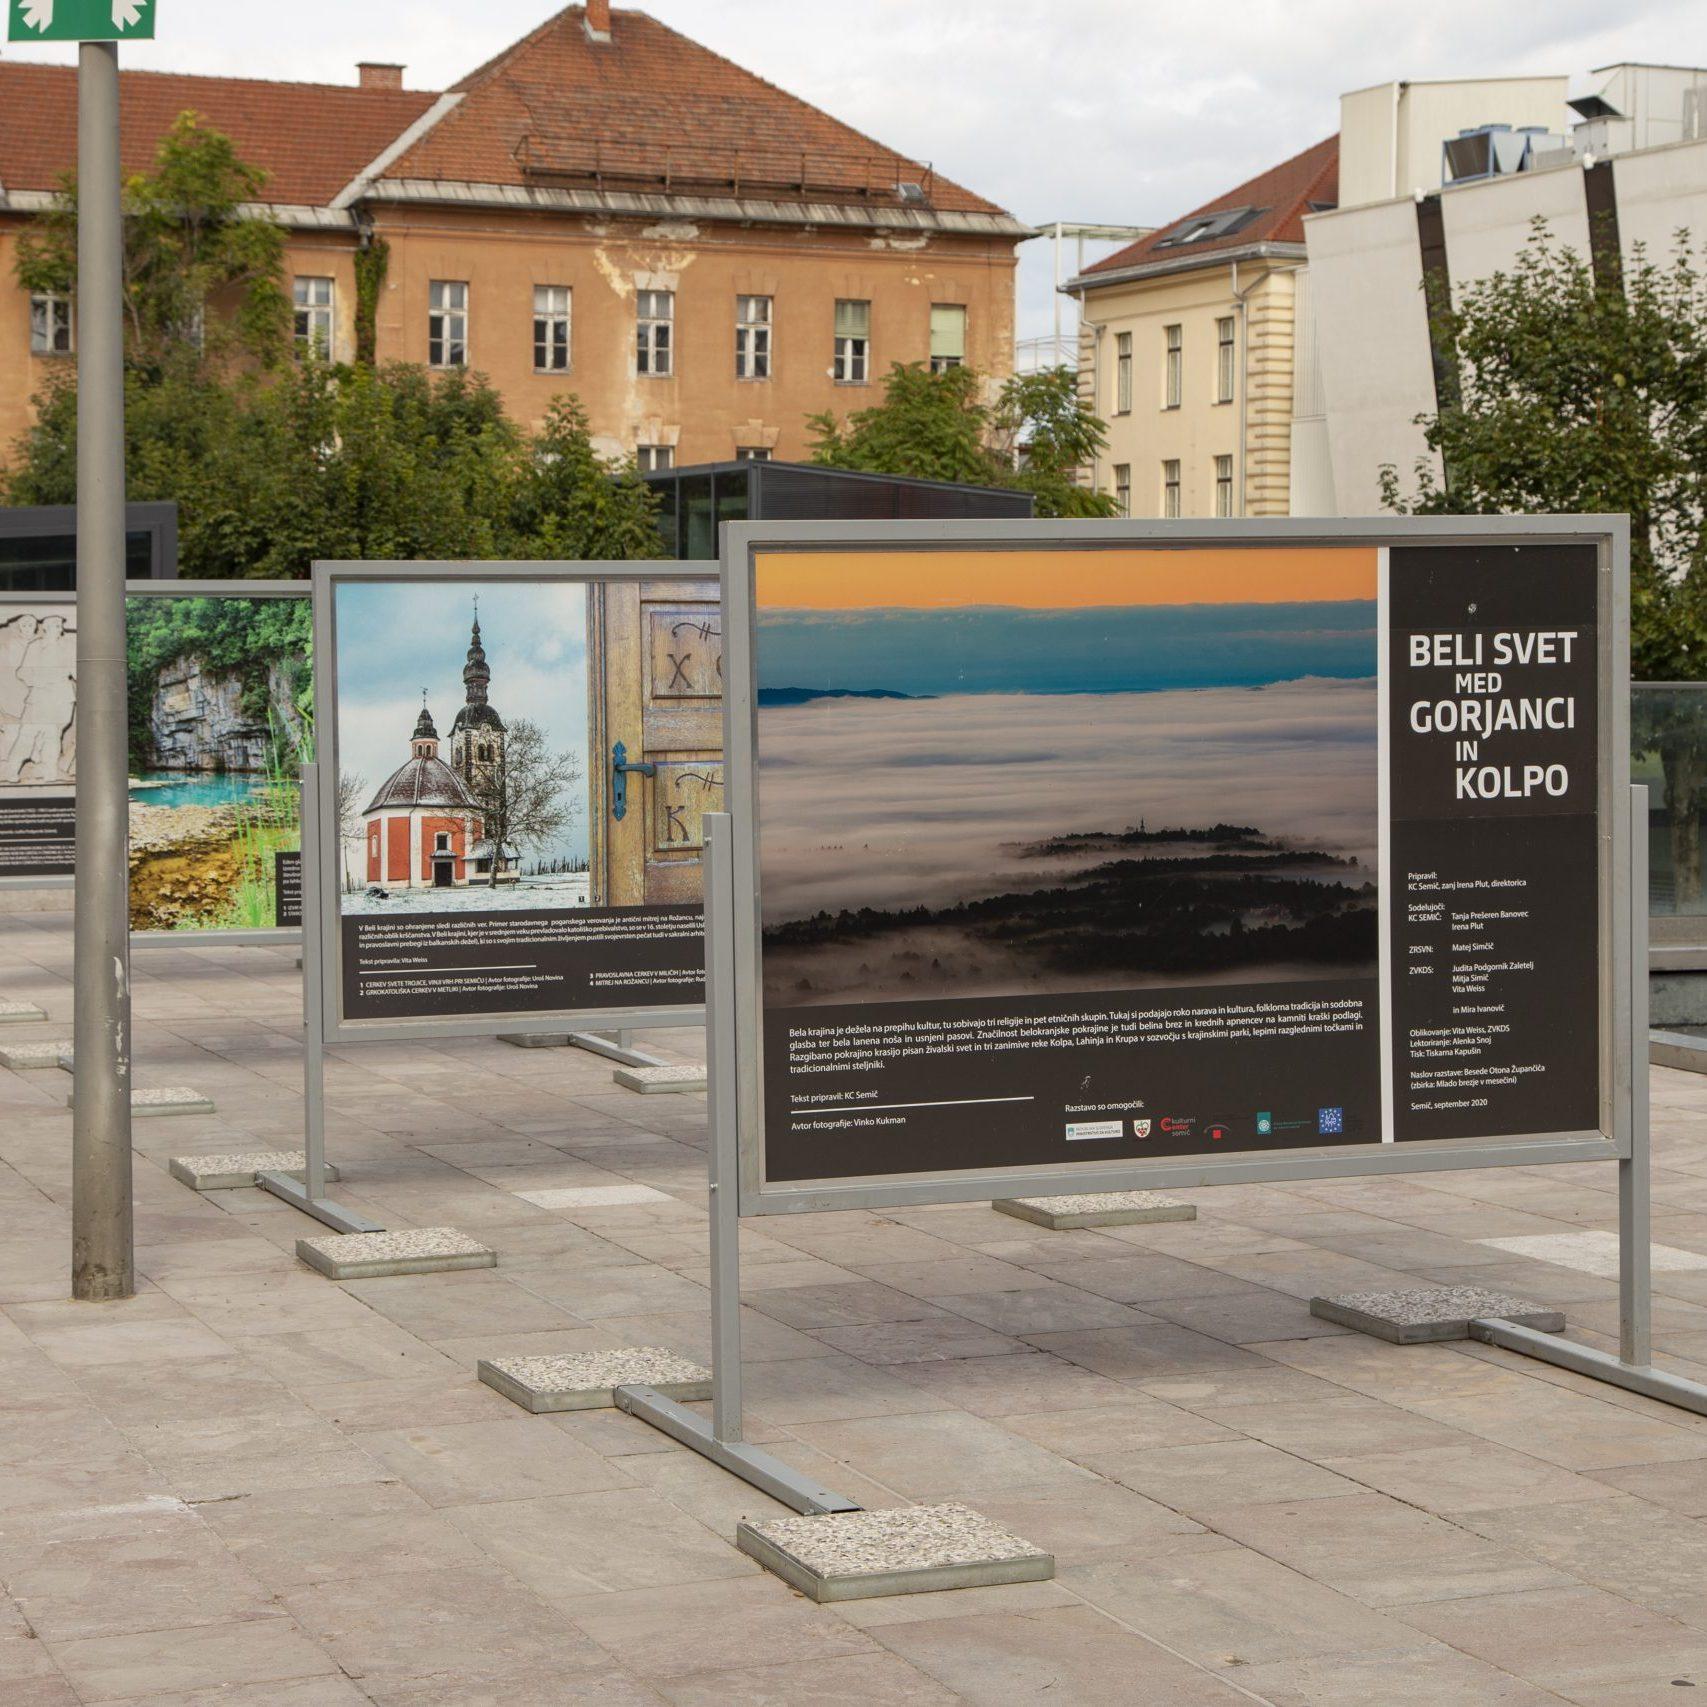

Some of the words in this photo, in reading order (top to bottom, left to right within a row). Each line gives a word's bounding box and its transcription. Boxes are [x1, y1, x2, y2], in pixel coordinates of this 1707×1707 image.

[1410, 634, 1482, 666] BELI
[1493, 632, 1578, 665] SVET
[1456, 672, 1502, 694] MED
[1410, 697, 1574, 740] GORJANCI
[1456, 740, 1478, 762] IN
[1456, 764, 1568, 799] KOLPO
[665, 805, 690, 842] K
[1442, 882, 1456, 890] zanj
[1457, 881, 1474, 889] Irena
[1475, 881, 1490, 889] Plut,
[1491, 879, 1526, 887] direktorica
[1451, 912, 1469, 921] Tanja
[1470, 922, 1484, 930] Plut
[1452, 943, 1471, 952] Matej
[1452, 964, 1473, 972] Judita
[1509, 962, 1534, 971] Zaletelj
[1452, 975, 1470, 984] Mitja
[1452, 985, 1465, 993] Vita
[1466, 984, 1485, 992] Weiss
[790, 1028, 807, 1037] Bela
[808, 1026, 835, 1037] krajina
[836, 1026, 844, 1036] je
[845, 1024, 871, 1034] dežela
[884, 1022, 915, 1034] prepihu
[917, 1021, 942, 1030] kultur,
[943, 1021, 952, 1029] tu
[953, 1019, 986, 1029] sobivajo
[987, 1018, 996, 1026] tri
[997, 1017, 1023, 1028] religije
[1025, 1016, 1032, 1024] in
[1033, 1016, 1046, 1026] pet
[1048, 1014, 1080, 1023] etničnih
[1081, 1012, 1109, 1023] skupin.
[1110, 1011, 1130, 1022] Tukaj
[1138, 1009, 1172, 1021] podajajo
[1173, 1008, 1191, 1017] roko
[1192, 1008, 1217, 1016] narava
[1218, 1006, 1226, 1015] in
[1227, 1005, 1255, 1014] kultura,
[1291, 1001, 1320, 1012] tradicija
[1330, 1000, 1363, 1009] sodobna
[790, 1039, 816, 1051] glasba
[833, 1038, 850, 1046] bela
[853, 1037, 880, 1045] lanena
[883, 1035, 902, 1044] noša
[905, 1034, 912, 1043] in
[916, 1032, 944, 1044] usnjeni
[947, 1031, 974, 1043] pasovi.
[977, 1029, 1018, 1039] Značilnost
[1020, 1026, 1070, 1037] belokranjske
[1072, 1024, 1109, 1036] pokrajine
[1111, 1024, 1119, 1034] je
[1121, 1022, 1136, 1031] tudi
[1140, 1021, 1163, 1030] belina
[1166, 1021, 1182, 1029] brez
[1185, 1020, 1192, 1028] in
[1195, 1018, 1224, 1028] krednih
[1226, 1018, 1263, 1028] apnencev
[1278, 1014, 1306, 1023] kamniti
[1308, 1012, 1330, 1022] kraški
[1332, 1011, 1363, 1022] podlagi.
[790, 1051, 832, 1062] Razgibano
[834, 1049, 872, 1061] pokrajino
[875, 1047, 900, 1058] krasijo
[902, 1046, 924, 1057] pisan
[926, 1044, 954, 1054] živalski
[956, 1044, 972, 1052] svet
[974, 1043, 982, 1051] in
[984, 1042, 992, 1051] tri
[994, 1040, 1030, 1050] zanimive
[1032, 1039, 1048, 1048] reke
[1050, 1038, 1074, 1048] Kolpa,
[1076, 1036, 1104, 1047] Lahinja
[1106, 1036, 1113, 1044] in
[1116, 1035, 1138, 1045] Krupa
[1146, 1032, 1180, 1043] sozvočju
[1188, 1029, 1229, 1041] krajinskimi
[1230, 1028, 1251, 1039] parki,
[1253, 1027, 1277, 1038] lepimi
[1278, 1024, 1322, 1036] razglednimi
[1324, 1022, 1354, 1032] točkami
[1356, 1022, 1363, 1030] in
[1453, 1037, 1476, 1045] Alenka
[1477, 1036, 1492, 1045] Snoj
[790, 1062, 850, 1073] tradicionalnimi
[852, 1060, 885, 1071] steljniki.
[1464, 1068, 1488, 1076] Besede
[1436, 1079, 1457, 1087] Mlado
[1459, 1078, 1479, 1087] brezje
[790, 1095, 810, 1103] Tekst
[844, 1092, 854, 1100] KC
[1065, 1104, 1096, 1112] Razstavo
[1434, 1100, 1470, 1110] september
[1472, 1099, 1488, 1107] 2020
[791, 1122, 811, 1130] Avtor
[813, 1119, 853, 1130] fotografije:
[854, 1118, 875, 1126] Vinko
[876, 1116, 906, 1125] Kukman
